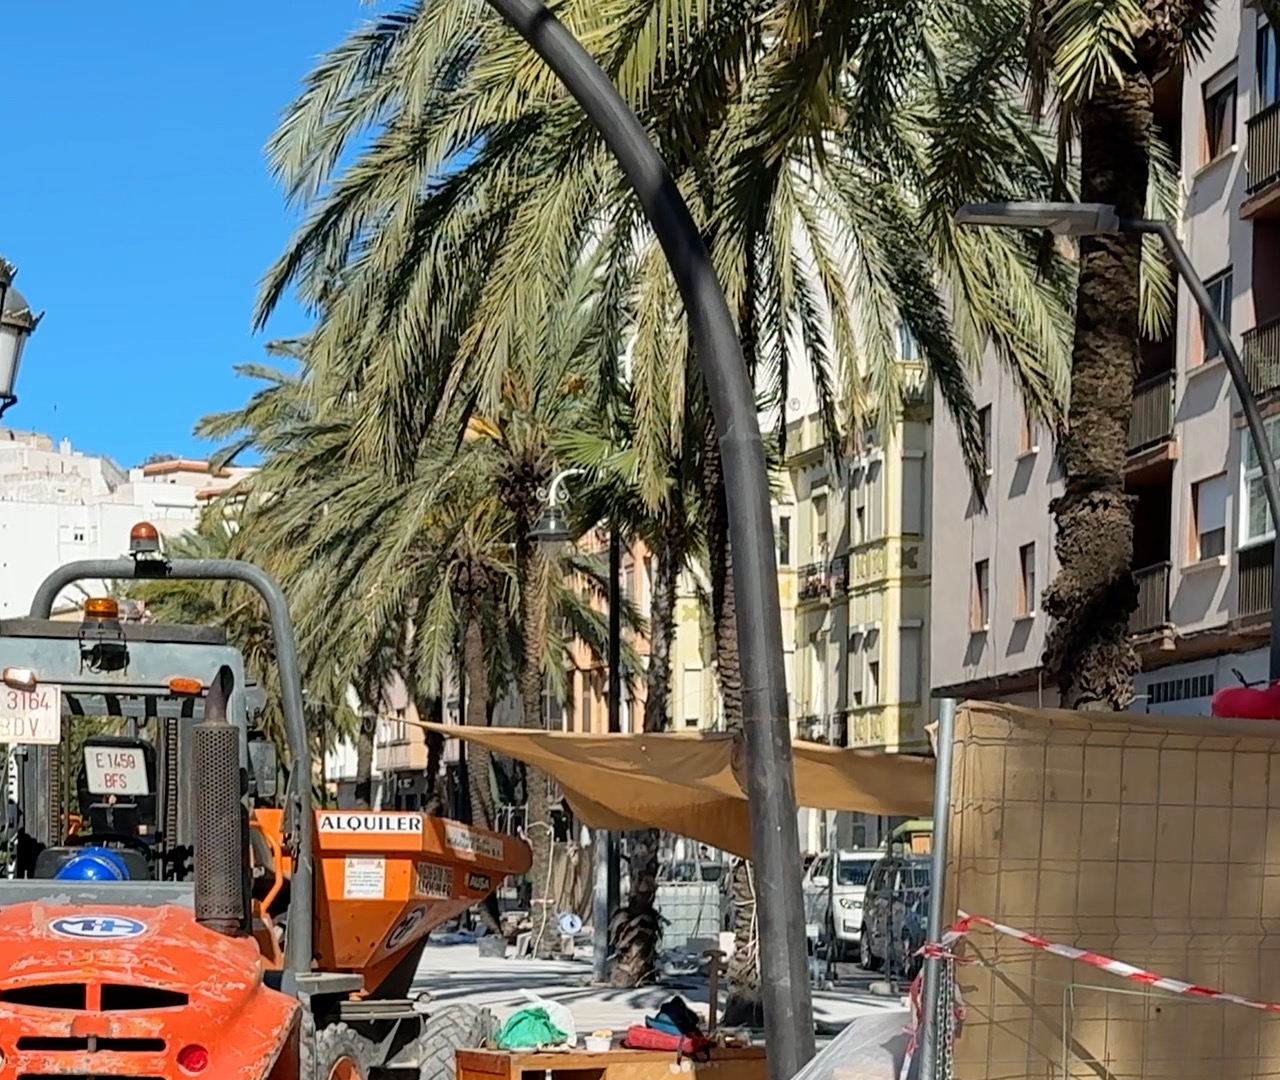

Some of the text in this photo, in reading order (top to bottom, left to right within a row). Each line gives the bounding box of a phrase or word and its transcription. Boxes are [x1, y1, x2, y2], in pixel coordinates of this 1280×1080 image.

[7, 690, 51, 711] 3164
[95, 752, 105, 768] E
[104, 772, 127, 789] BFS
[320, 816, 421, 831] ALQUILER
